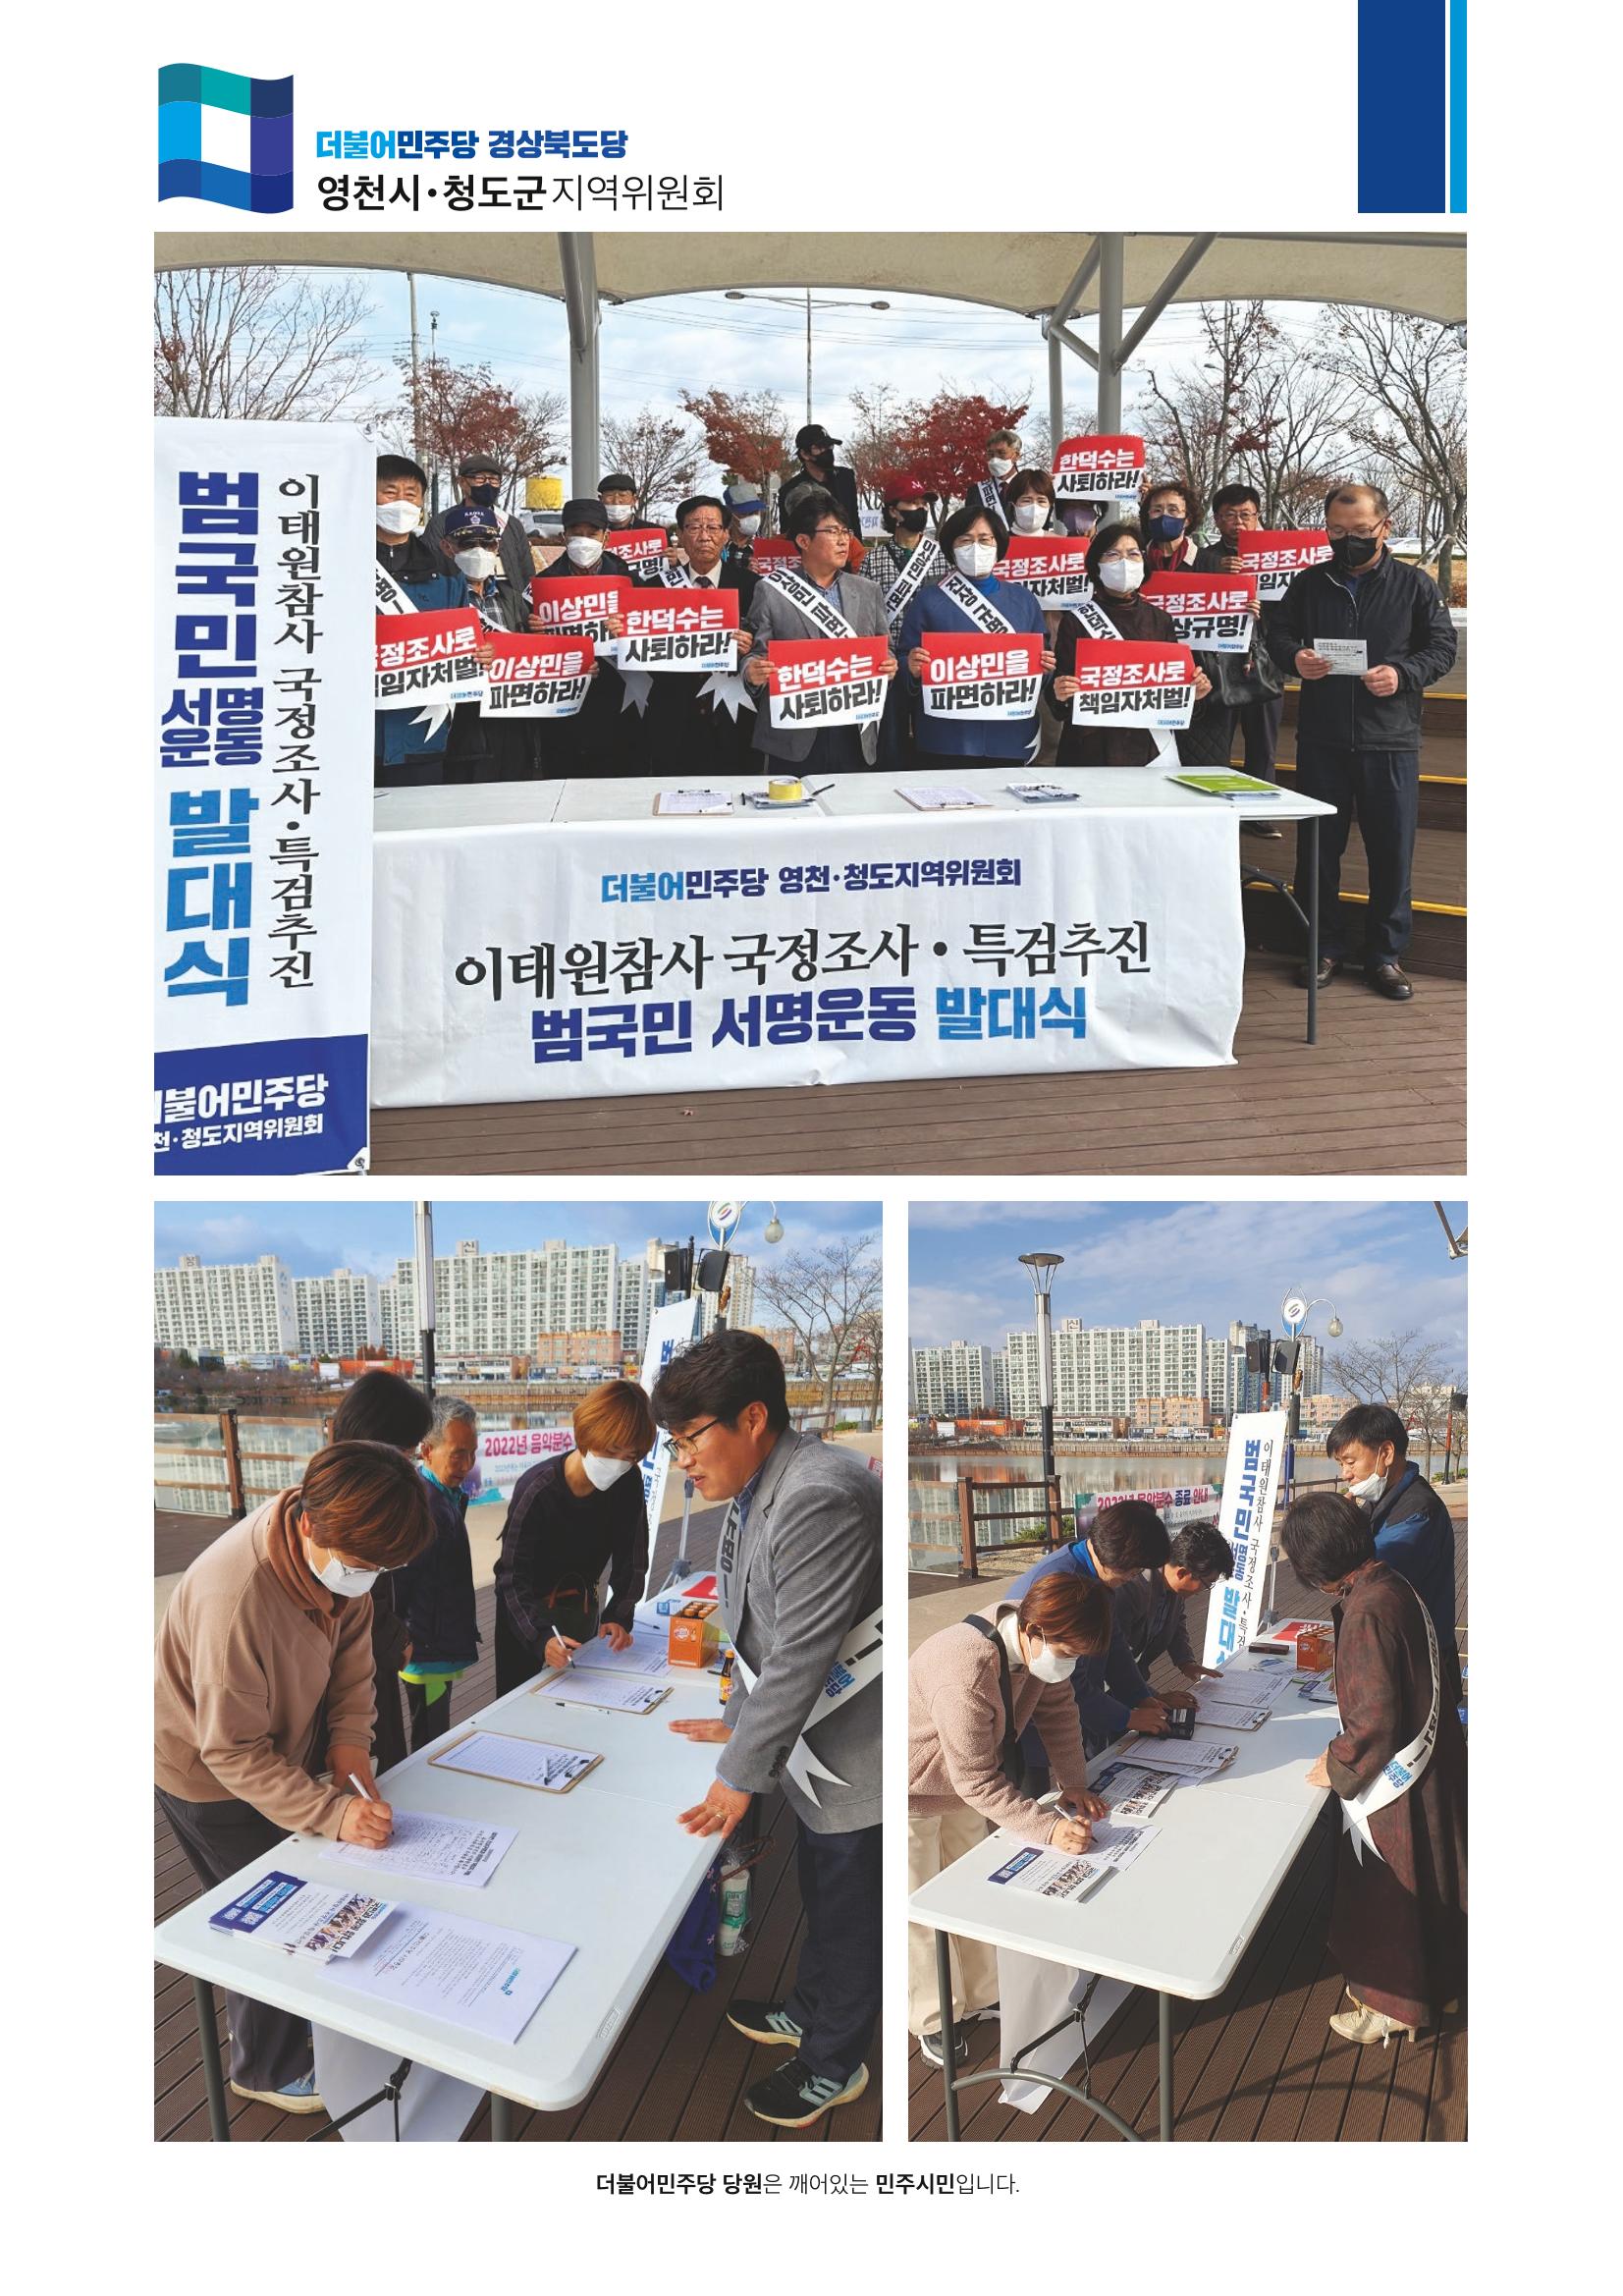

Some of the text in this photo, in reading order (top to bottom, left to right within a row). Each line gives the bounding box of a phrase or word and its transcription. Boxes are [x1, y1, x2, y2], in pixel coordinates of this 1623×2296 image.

[1059, 448, 1135, 472] 한덕수는
[1057, 469, 1140, 492] 사퇴하라!
[175, 471, 258, 678] 범국민
[274, 473, 323, 654] 이태원참사
[993, 552, 1085, 578] 국정조사로
[1242, 546, 1333, 571] 국정조사로
[626, 606, 724, 635] 한덕수는
[625, 631, 730, 663] 사퇴하라!
[491, 651, 583, 680] 이상민을
[778, 654, 873, 693] 한덕수는
[930, 649, 1029, 683] 이상민을
[1080, 661, 1185, 688] 국정조사로
[489, 677, 585, 710] 파면하라!
[780, 679, 883, 721] 사퇴하라!
[930, 678, 1037, 710] 파면하라!
[1079, 686, 1191, 715] 책임자처벌!
[164, 788, 259, 1007] 발대식
[601, 866, 767, 903] 더불어민주당
[456, 933, 706, 1003] 이태원참사
[532, 987, 1087, 1063] 범국민 서명운동 발대식
[485, 1432, 571, 1456] 2022년 음악분수
[1175, 1490, 1191, 1506] 종료
[1193, 1488, 1209, 1504] 안내
[1233, 1440, 1261, 1541] 범국민
[1253, 1440, 1273, 1532] 이태원참사
